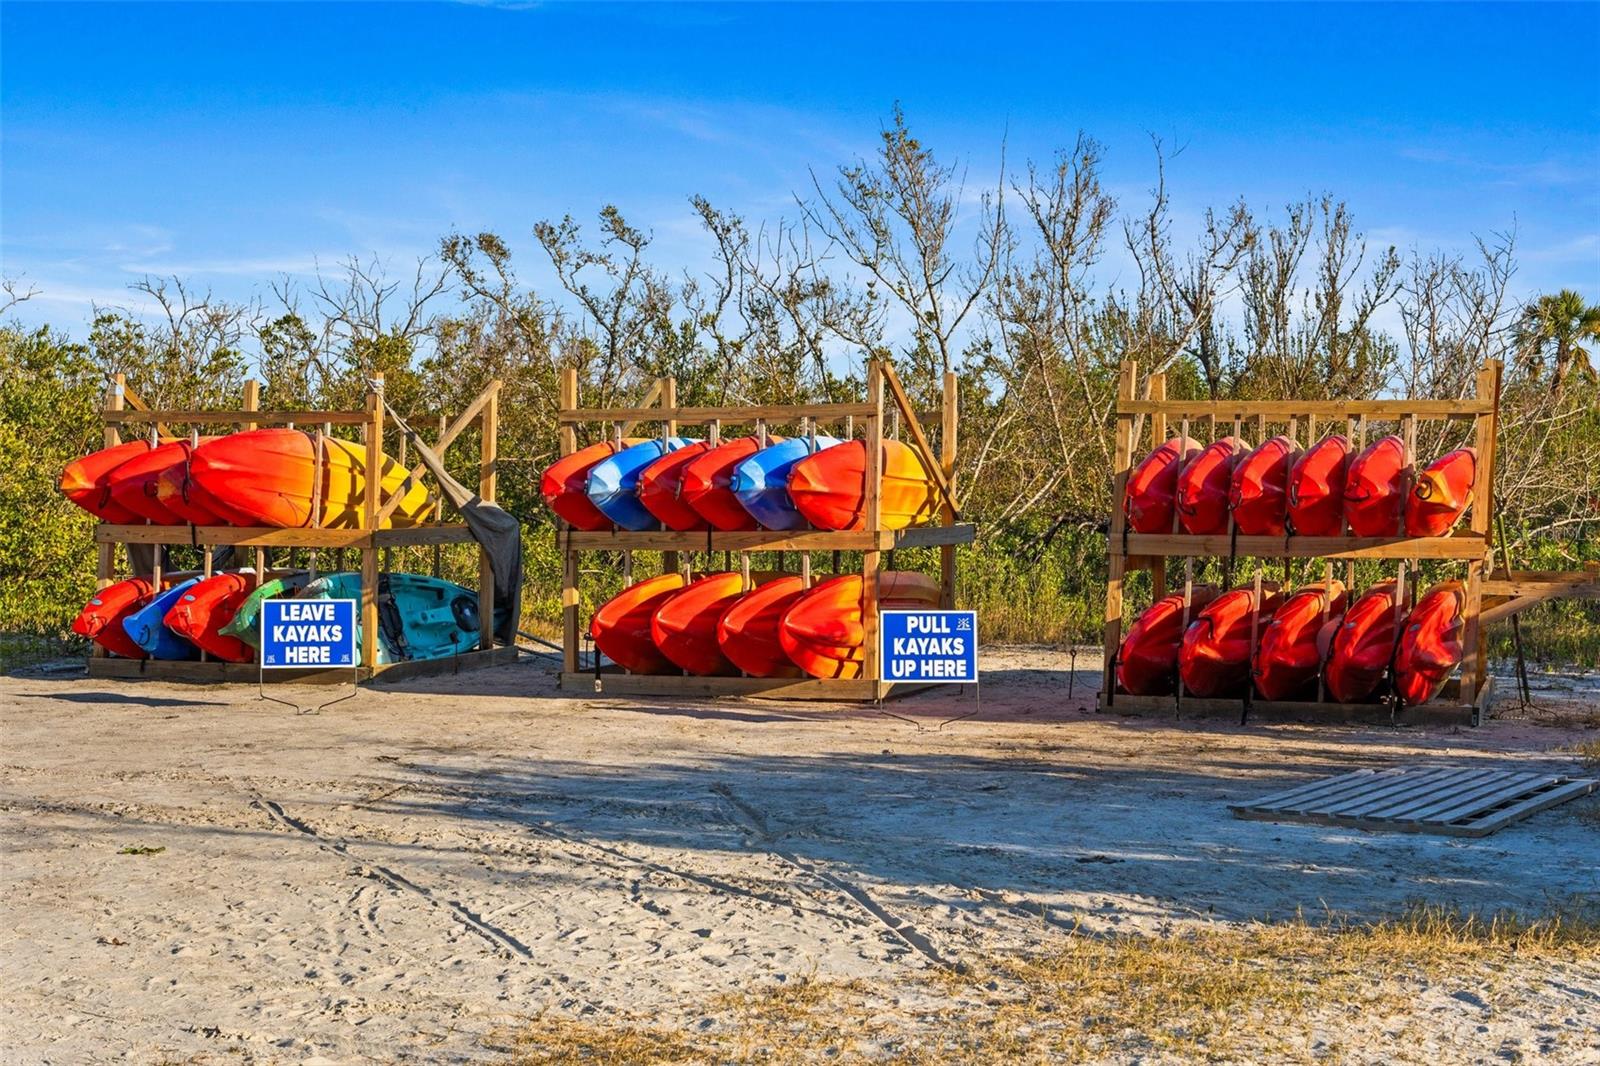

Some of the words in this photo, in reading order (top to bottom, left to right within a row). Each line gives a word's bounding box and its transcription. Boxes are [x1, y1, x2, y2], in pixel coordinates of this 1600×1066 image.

[281, 604, 334, 621] LEAVE
[907, 616, 950, 633] PULL
[274, 625, 342, 642] KAYAKS
[286, 646, 330, 663] HERE
[894, 638, 964, 655] KAYAKS
[892, 660, 916, 677] UP
[921, 660, 966, 676] HERE
